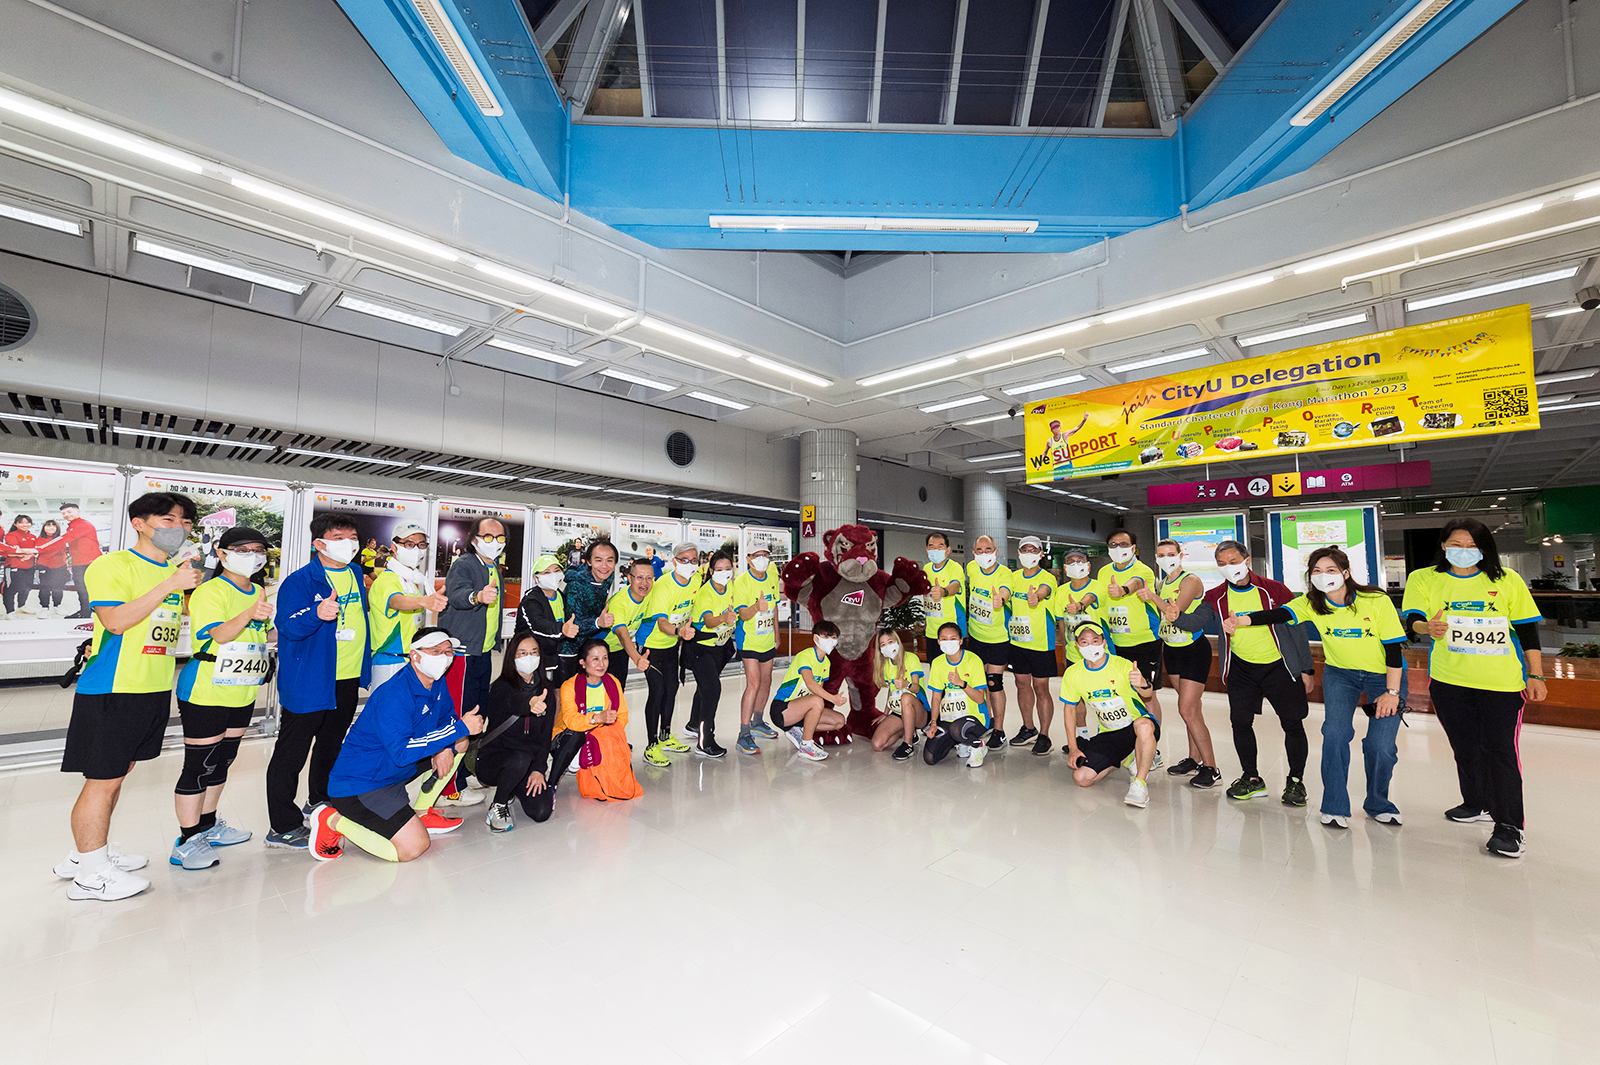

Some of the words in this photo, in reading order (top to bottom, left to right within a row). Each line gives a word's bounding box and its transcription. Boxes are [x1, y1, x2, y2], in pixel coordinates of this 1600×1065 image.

[1122, 394, 1156, 425] join
[1162, 378, 1222, 401] CityU
[1231, 352, 1381, 389] Delegation
[1139, 418, 1182, 431] Standard
[1185, 409, 1237, 423] Chartered
[1240, 405, 1269, 415] Hong
[1273, 400, 1303, 410] Kong
[1307, 389, 1368, 405] Marathon
[1373, 383, 1407, 396] 2023
[1421, 403, 1454, 411] Cheering
[1030, 455, 1050, 468] We
[1053, 432, 1117, 462] SUPPORT
[1225, 483, 1240, 496] A
[1250, 482, 1267, 492] 4F
[804, 524, 813, 535] A
[970, 604, 991, 618] P2367
[1010, 626, 1030, 634] P2988
[1452, 630, 1505, 644] P4942
[220, 659, 268, 673] P2440
[941, 701, 966, 712] K4709
[1096, 708, 1127, 721] K4698
